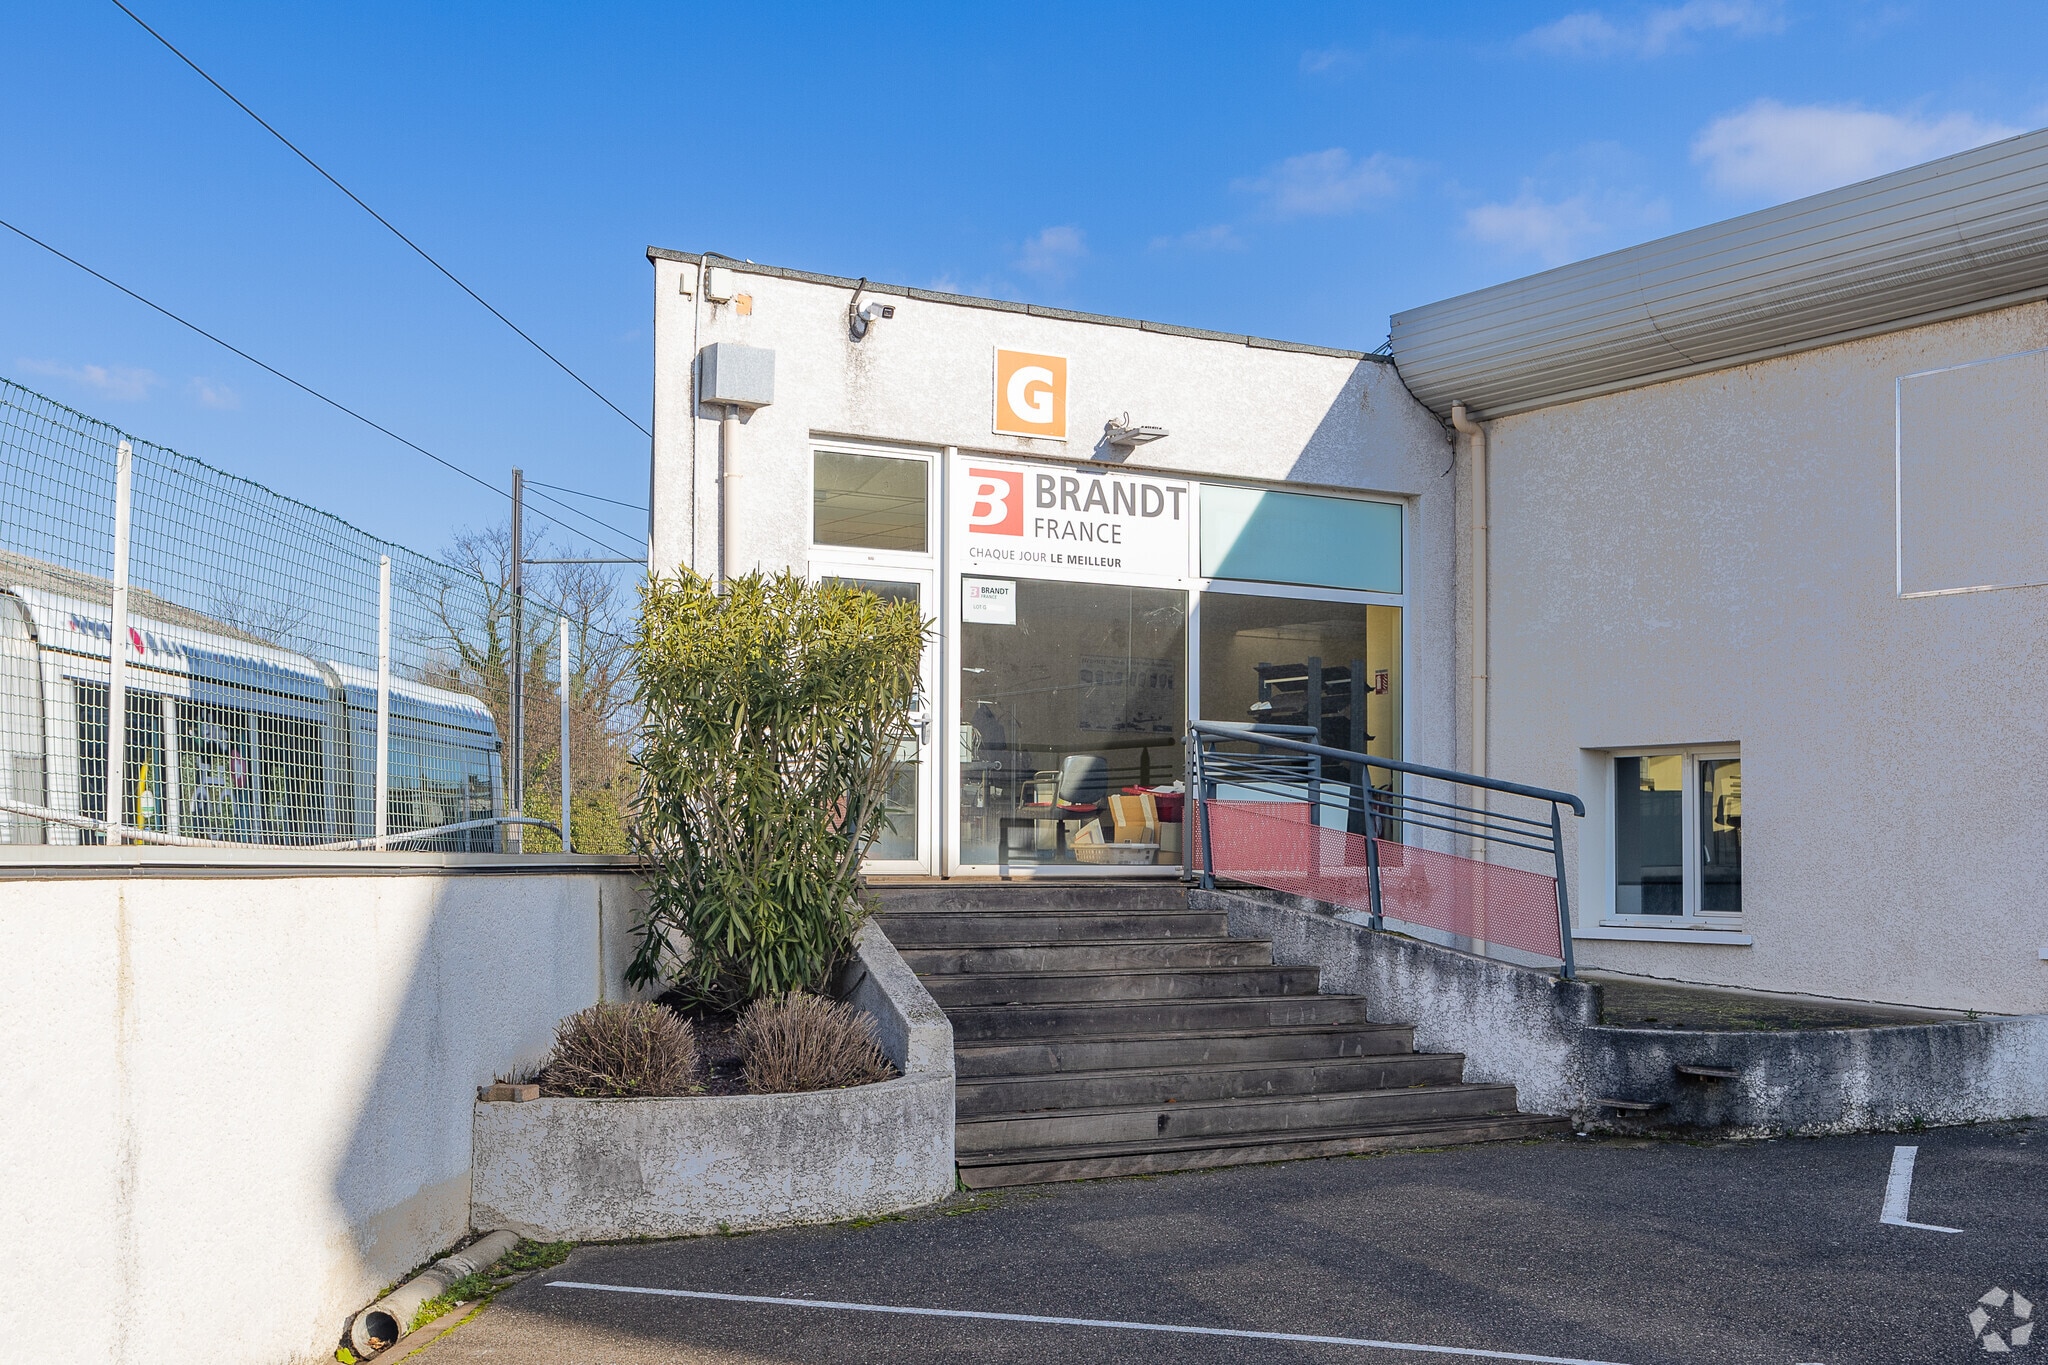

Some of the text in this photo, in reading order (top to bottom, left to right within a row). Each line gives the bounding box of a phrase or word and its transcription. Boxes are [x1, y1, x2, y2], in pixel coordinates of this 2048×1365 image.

[1006, 366, 1054, 424] G
[1036, 473, 1187, 520] BRANDT
[1034, 518, 1122, 544] FRANCE
[969, 547, 1122, 568] CHAQUE JOUR LE MEILLEUR
[981, 586, 1009, 595] BRANDT
